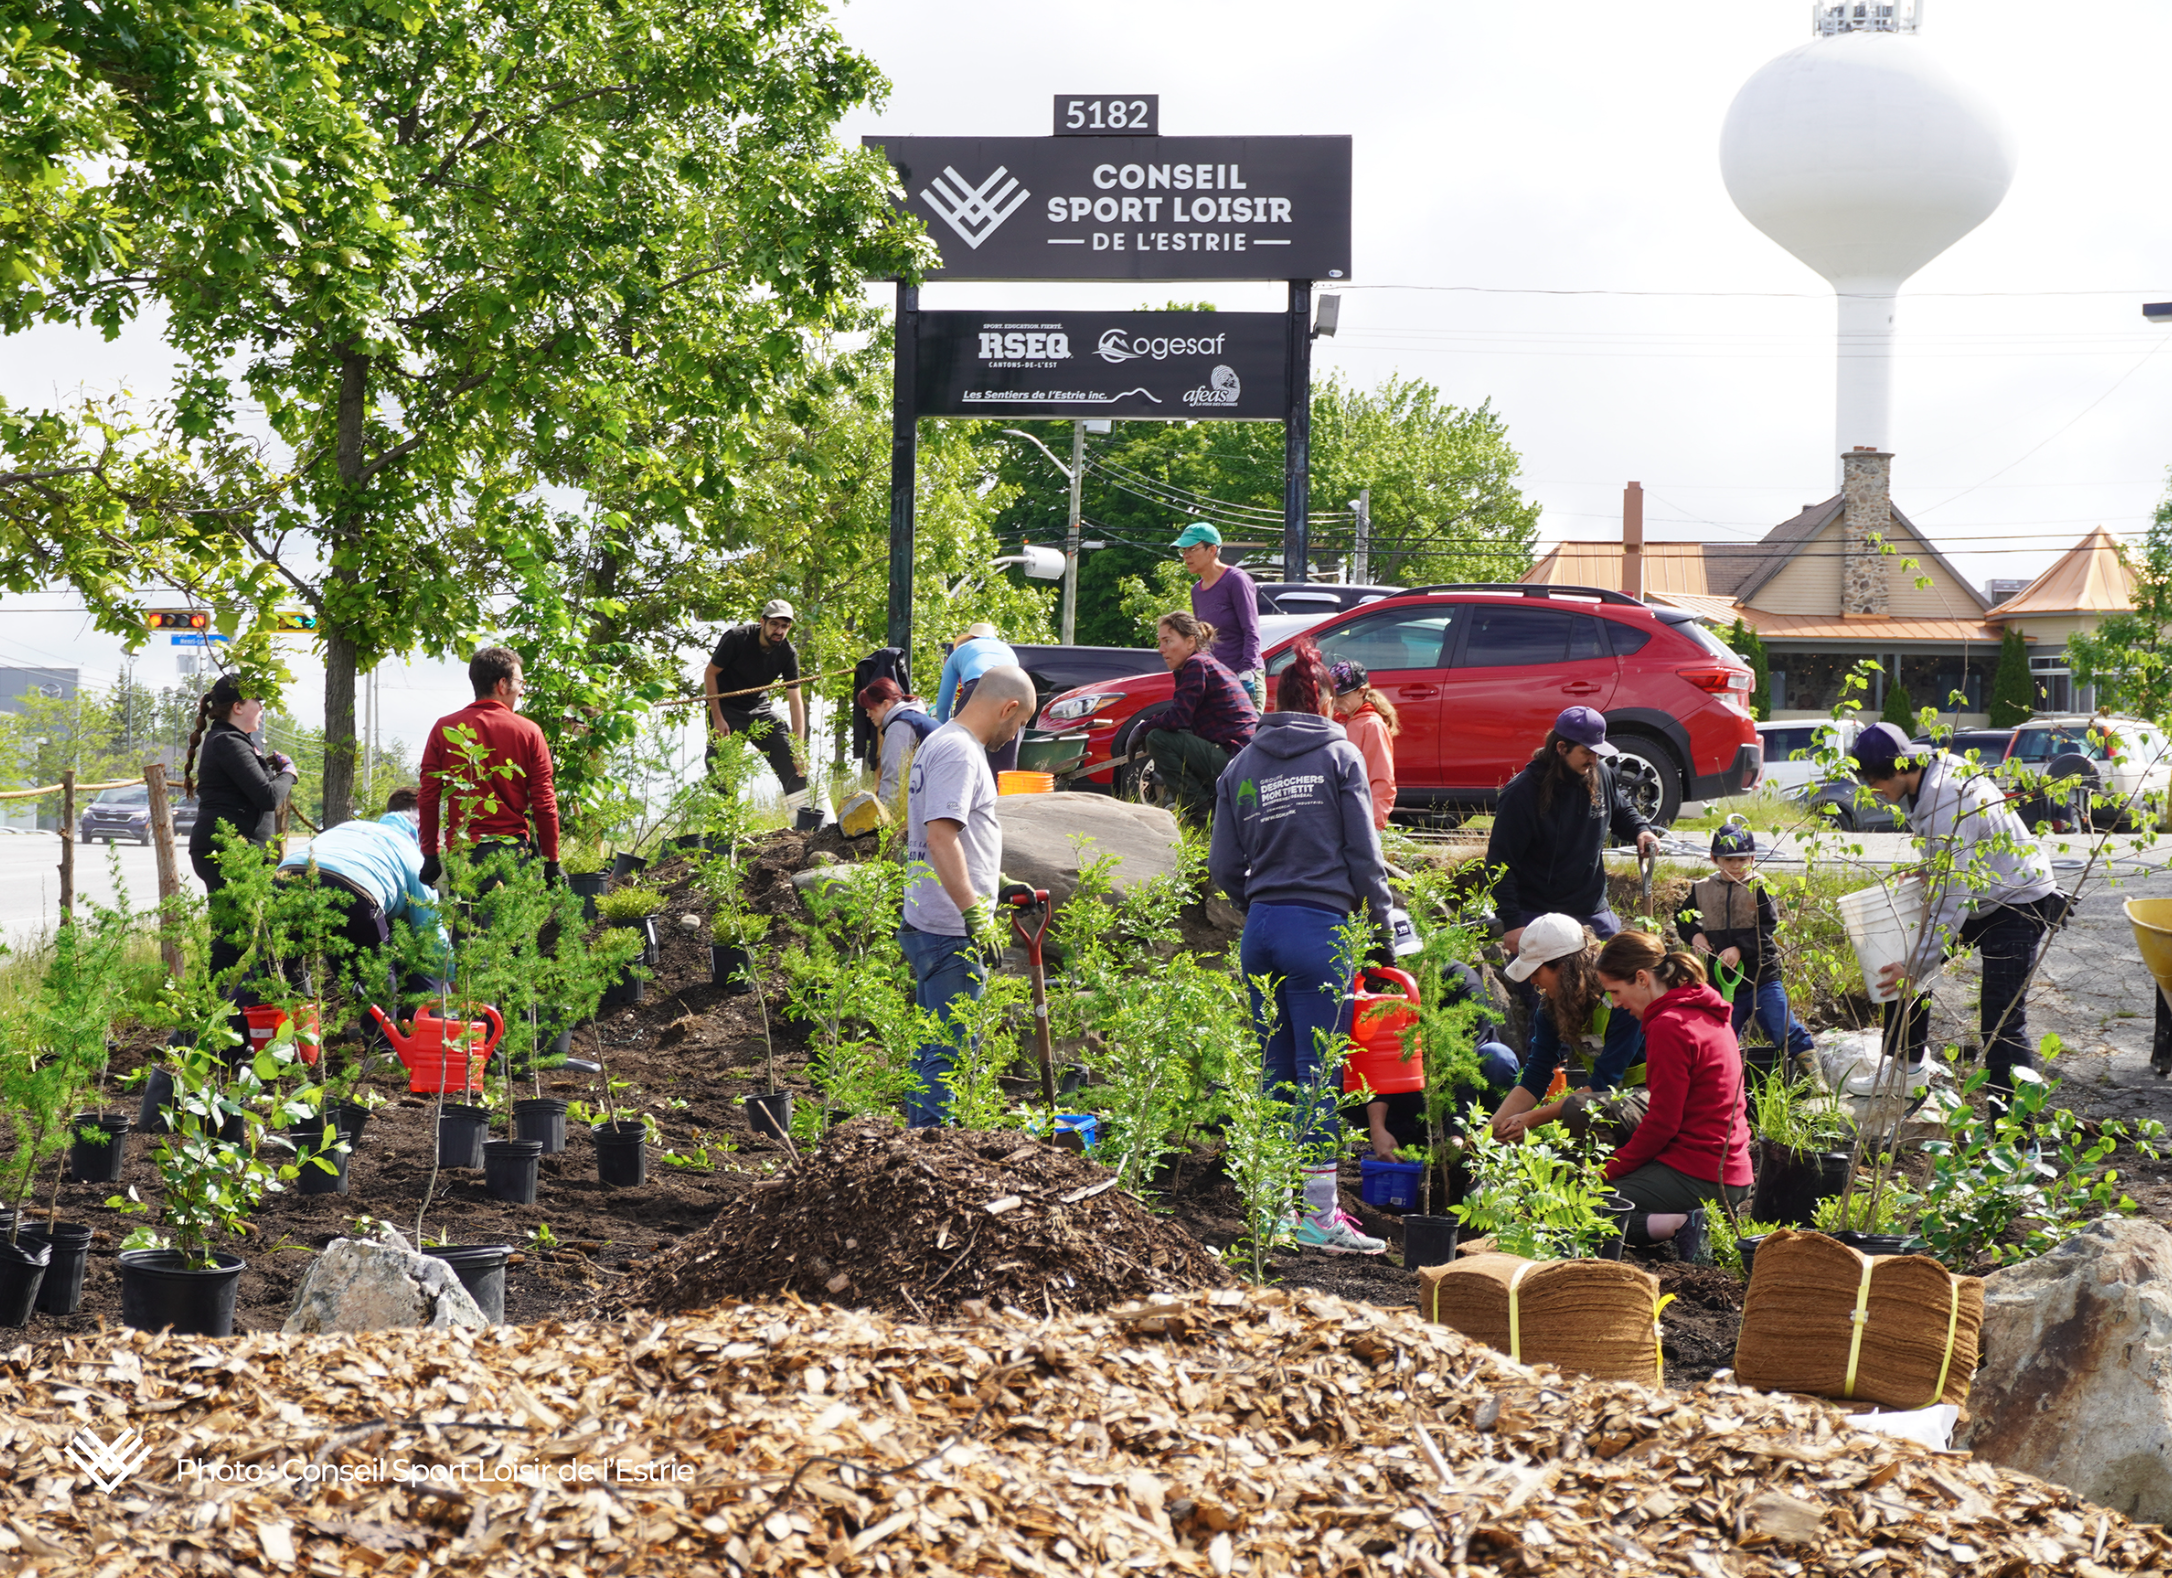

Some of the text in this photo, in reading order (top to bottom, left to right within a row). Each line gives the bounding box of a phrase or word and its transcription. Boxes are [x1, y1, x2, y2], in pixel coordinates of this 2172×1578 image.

[1066, 100, 1149, 129] 5182
[1092, 163, 1247, 190] CONSEIL
[1047, 196, 1293, 223] SPORT LOISIR
[1092, 232, 1247, 252] DE L'ESTRIE
[978, 332, 1072, 359] RSEQ
[988, 361, 1058, 369] CANTONS-DE-L'EST
[963, 390, 1108, 399] Les Sentiers de l'Estrie inc.
[1182, 385, 1229, 407] afeas
[1260, 775, 1324, 793] DESROCHERS
